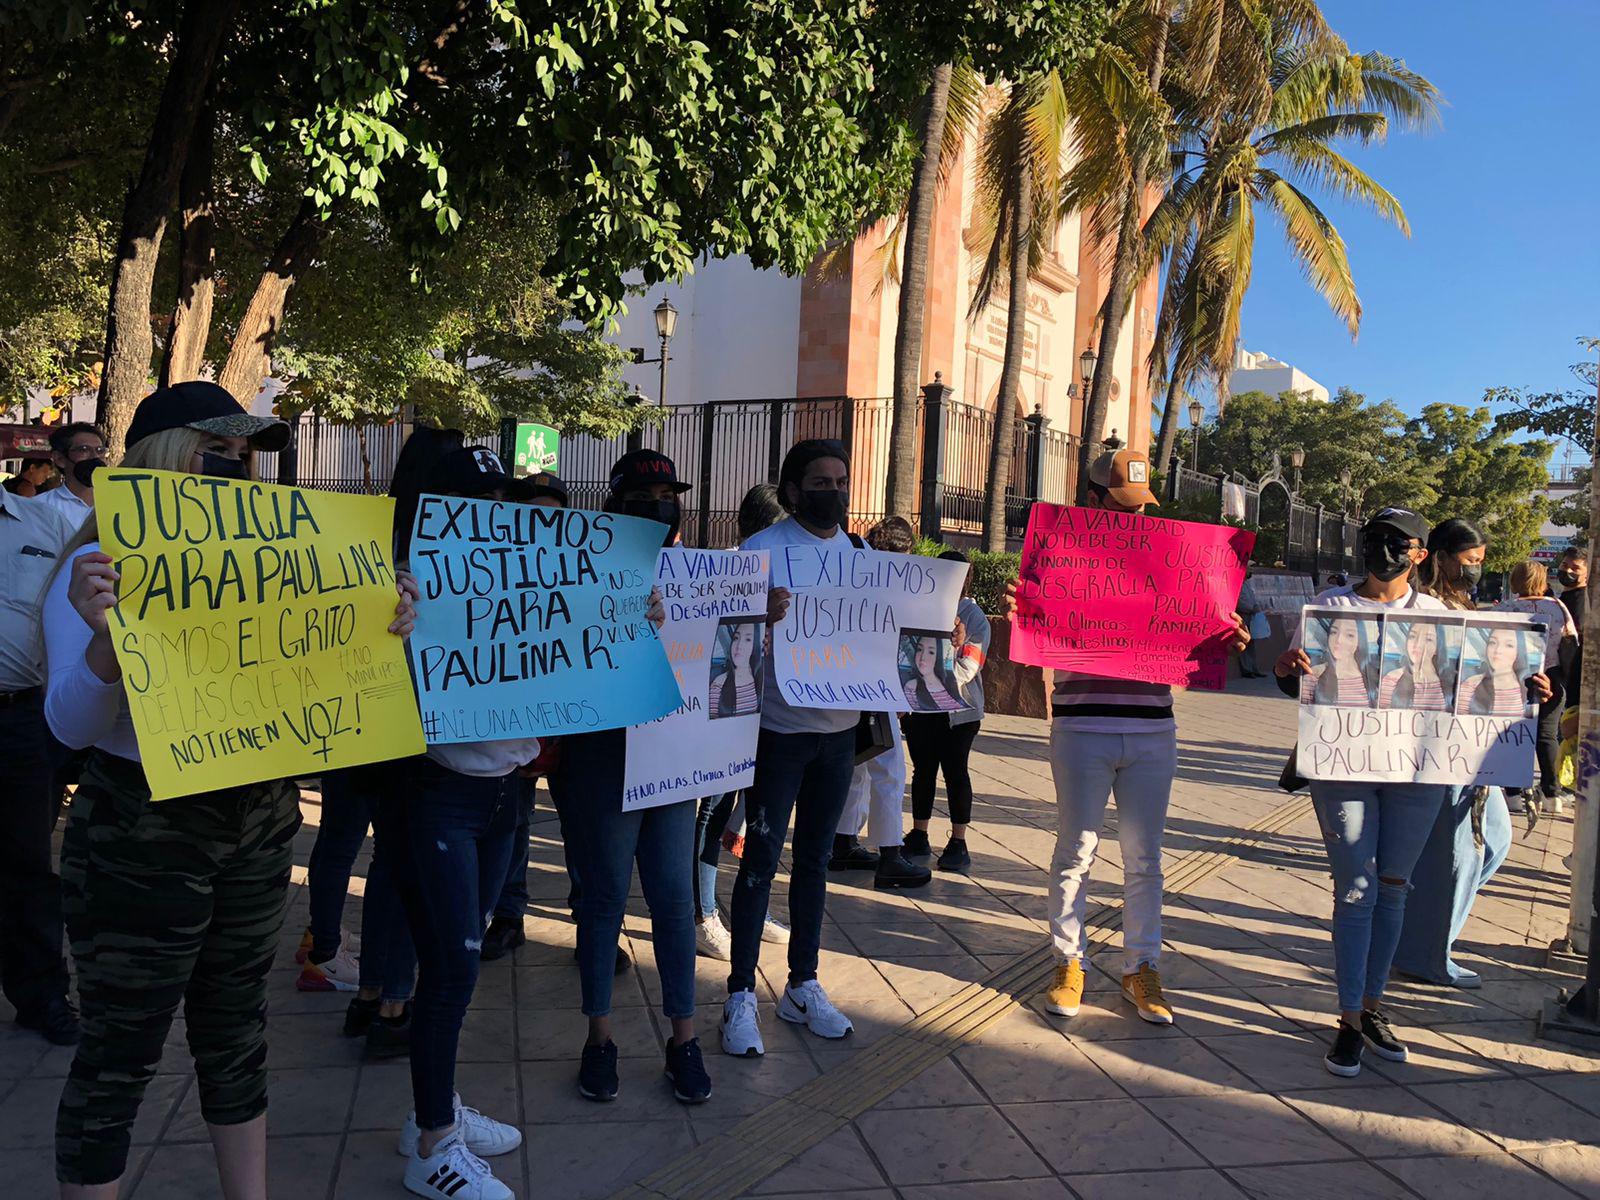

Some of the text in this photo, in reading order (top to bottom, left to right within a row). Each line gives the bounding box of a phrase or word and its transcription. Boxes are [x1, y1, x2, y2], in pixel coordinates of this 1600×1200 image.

[108, 474, 320, 549] JUSTICIA
[416, 498, 615, 555] EXIGIMOS
[1034, 505, 1185, 537] LA VANIDAD
[1033, 532, 1153, 551] NO DEBE SER
[1164, 541, 1249, 570] JUSTICIA
[682, 552, 760, 580] VANIDAD
[785, 545, 937, 595] EXIGIMOS
[1028, 551, 1128, 570] SINONIMO DE
[690, 580, 715, 599] SER
[1022, 572, 1158, 602] DESGRACIA
[1177, 568, 1230, 594] PARA
[465, 590, 572, 640] PARA
[786, 592, 898, 643] JUSTICIA
[1148, 614, 1221, 638] RAMIREZ
[122, 604, 355, 693] SOMOS EL GRITO
[582, 625, 620, 670] R.
[790, 643, 855, 676] PARA
[474, 706, 523, 739] UNA
[1318, 708, 1536, 748] JUSTICIA PARA
[1305, 742, 1440, 776] PAULINA
